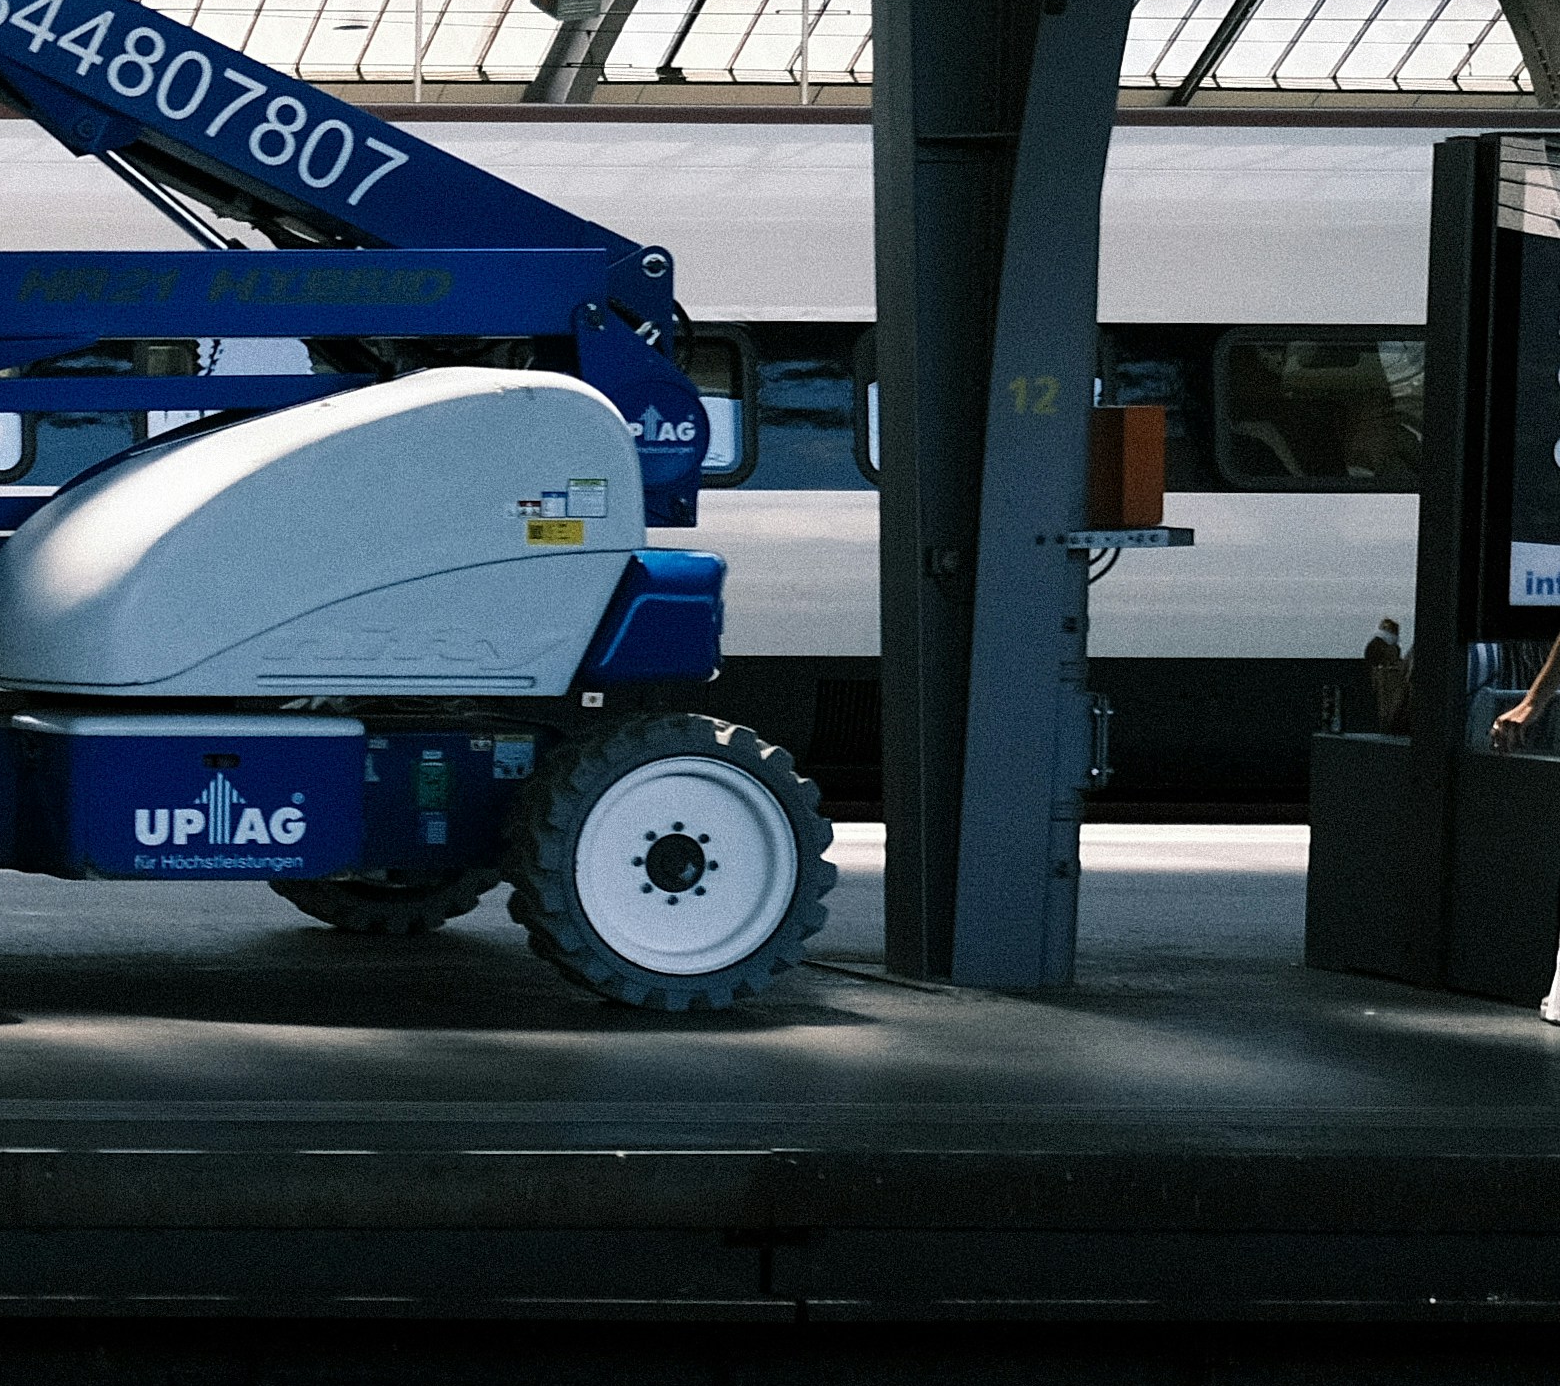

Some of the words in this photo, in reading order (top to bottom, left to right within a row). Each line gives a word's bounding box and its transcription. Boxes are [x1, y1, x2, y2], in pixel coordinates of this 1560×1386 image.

[1009, 376, 1061, 415] 12
[133, 854, 156, 870] für
[160, 854, 305, 872] Höchstleistungen
